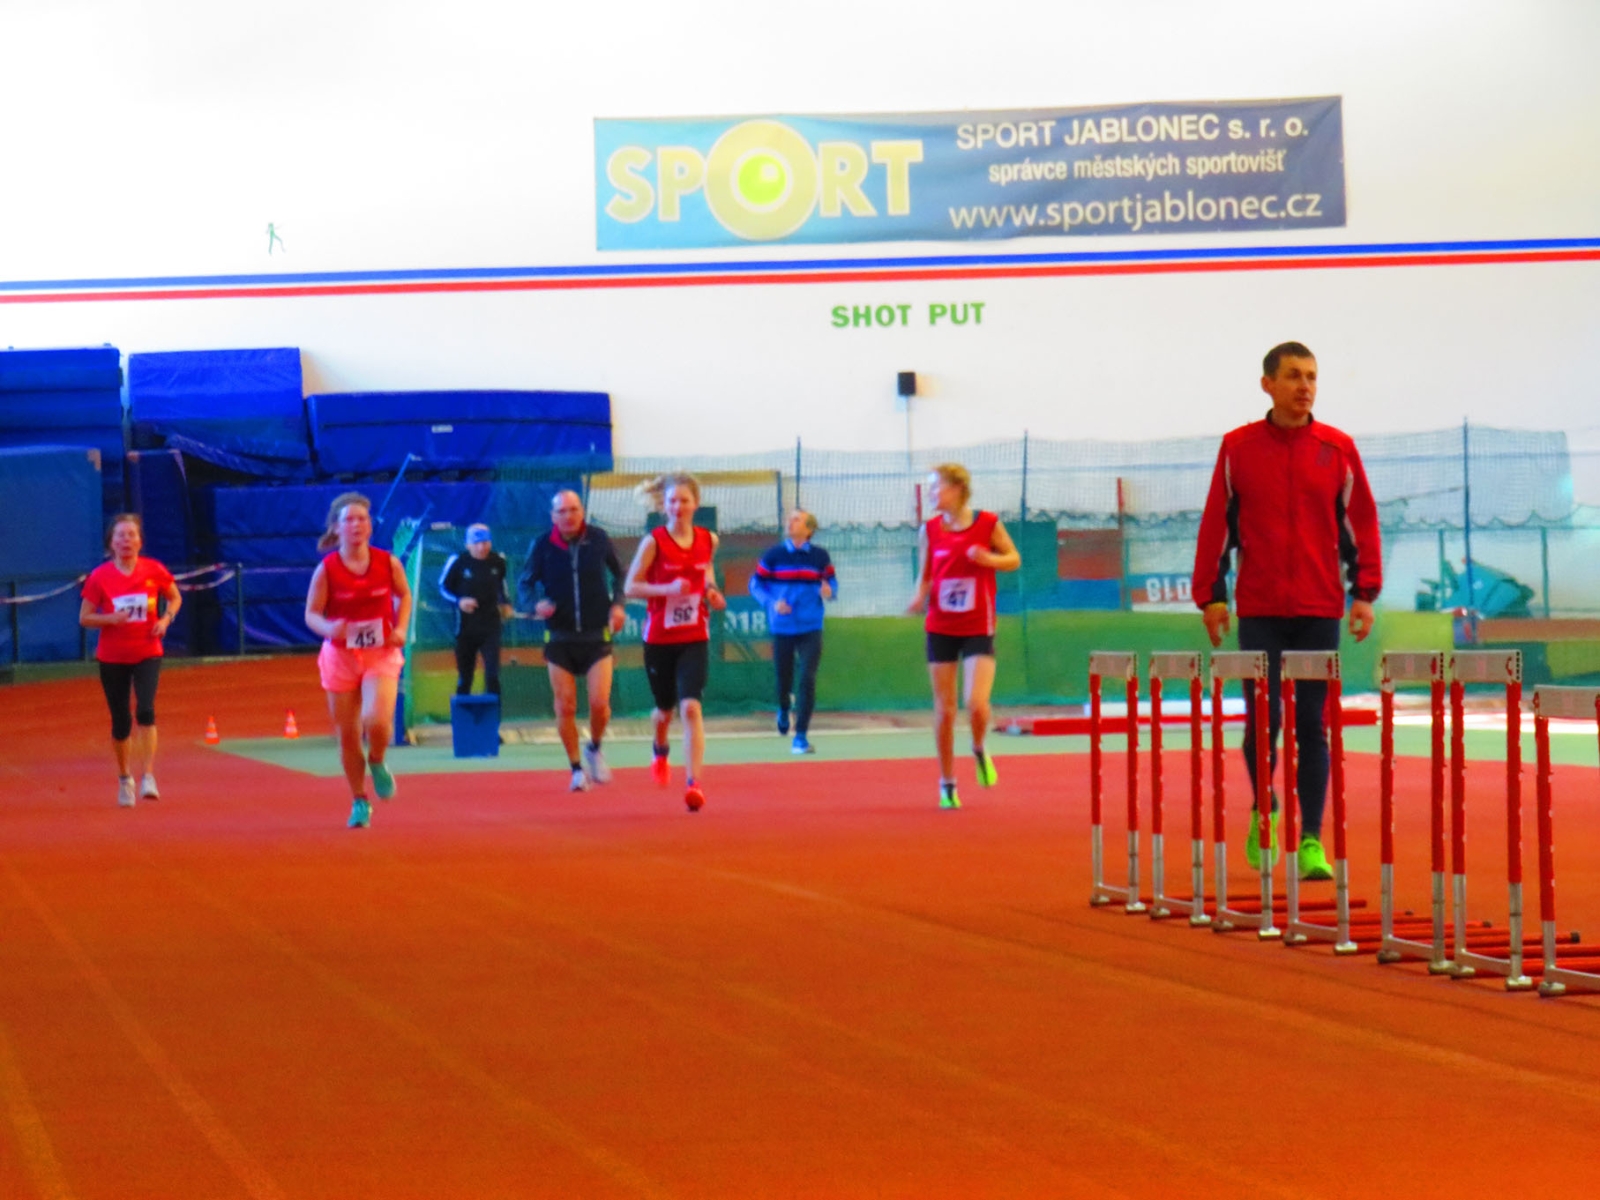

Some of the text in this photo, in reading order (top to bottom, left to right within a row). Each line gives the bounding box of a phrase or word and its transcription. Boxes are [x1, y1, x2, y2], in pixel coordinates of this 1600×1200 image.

[956, 114, 1310, 150] SPORT JABLONEC s. r. o.
[606, 119, 923, 241] SPORT
[988, 148, 1288, 186] správce městských sportovišť
[948, 191, 1323, 231] www.sportjablonec.cz
[831, 302, 985, 328] SHOT PUT
[355, 630, 376, 647] 45
